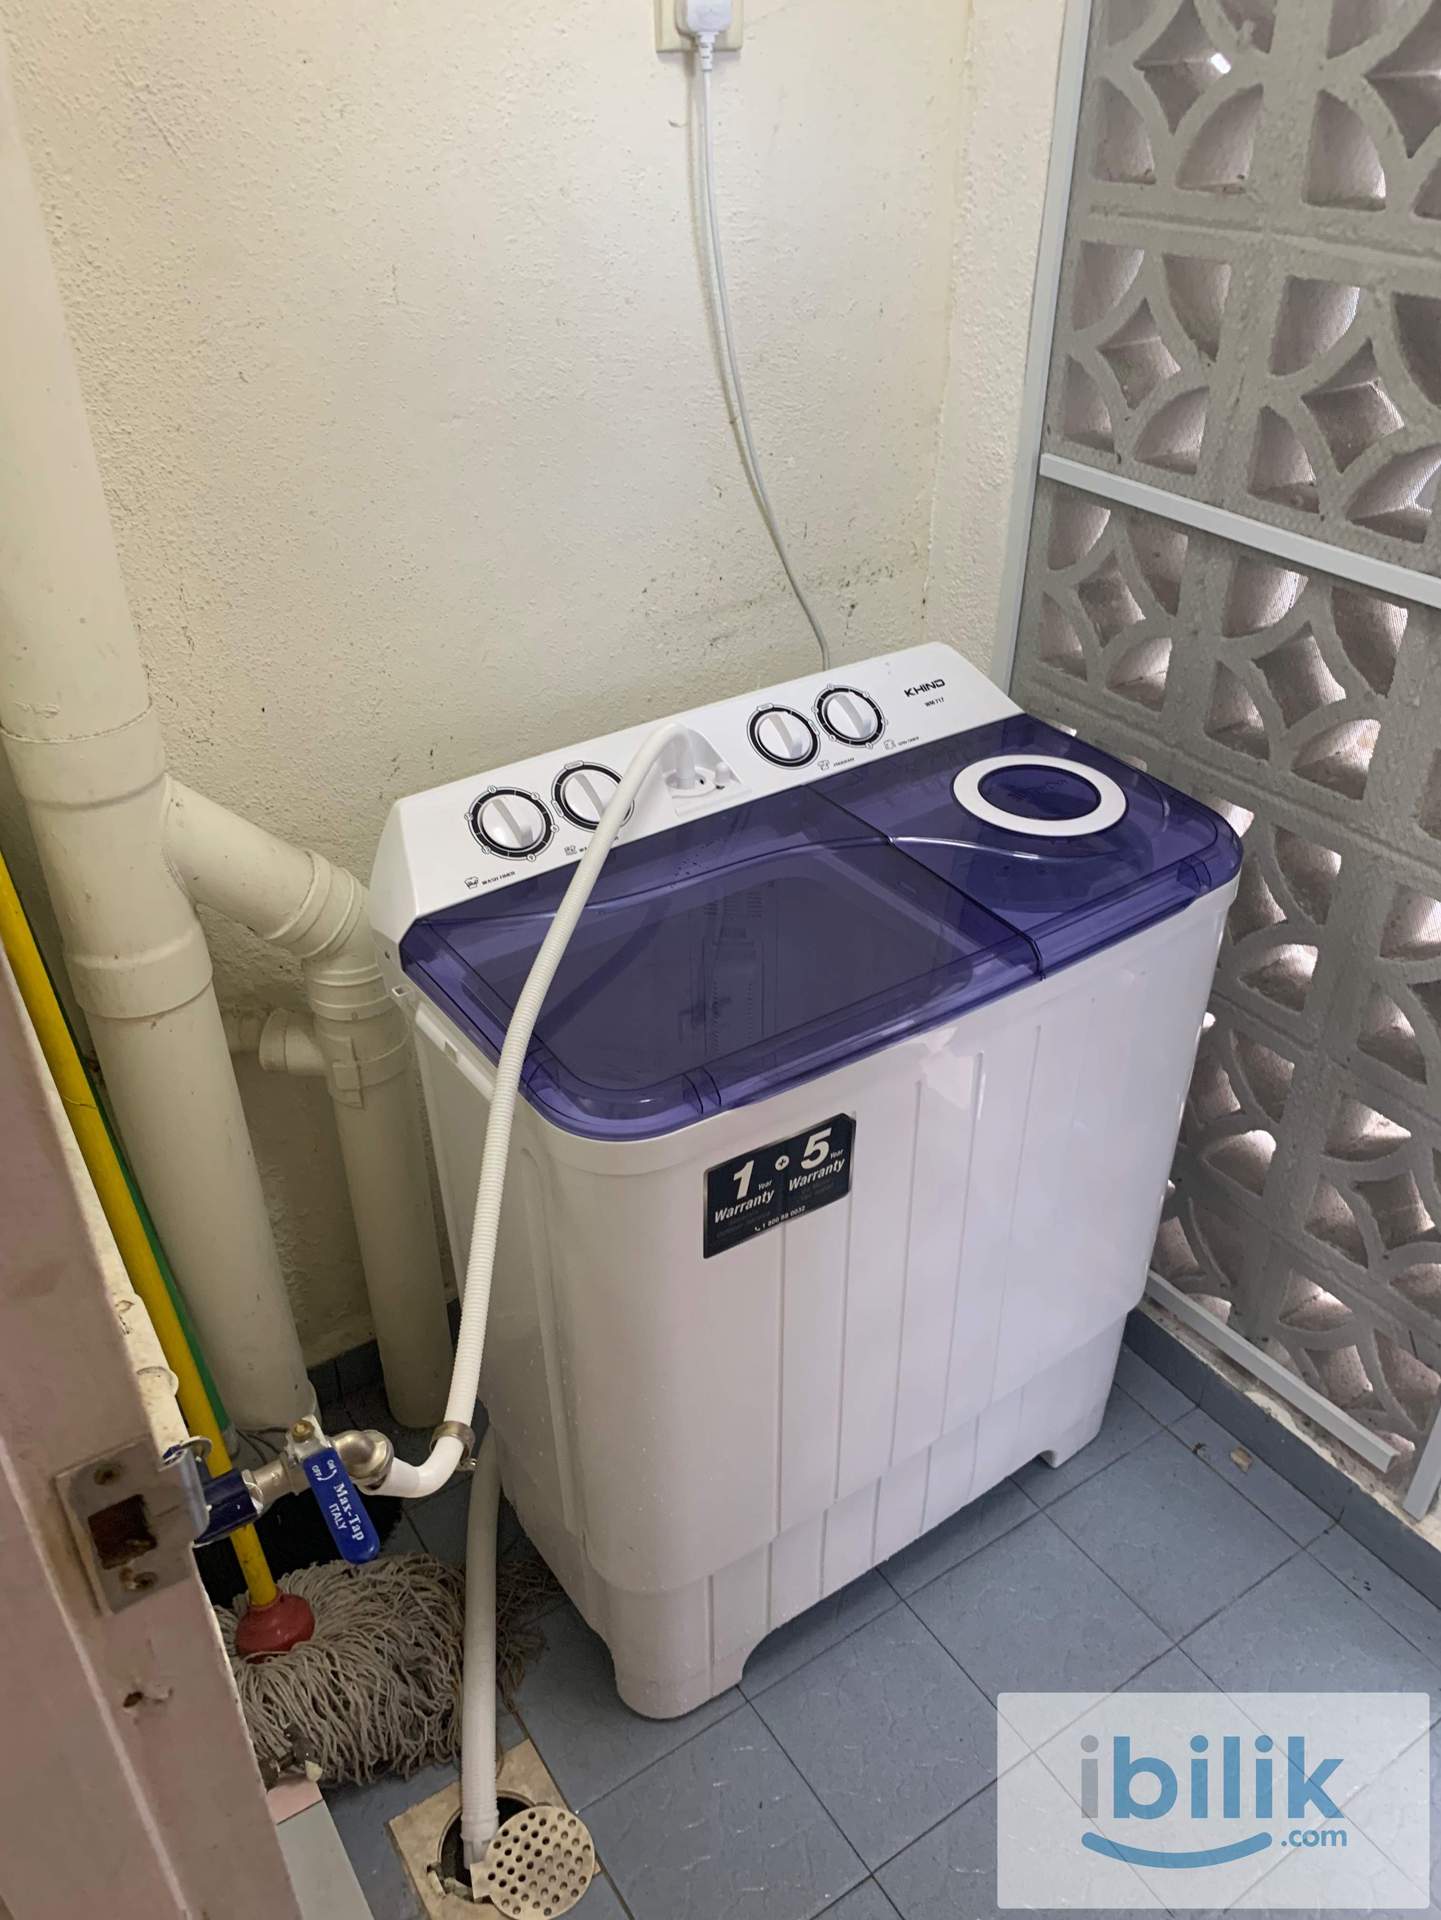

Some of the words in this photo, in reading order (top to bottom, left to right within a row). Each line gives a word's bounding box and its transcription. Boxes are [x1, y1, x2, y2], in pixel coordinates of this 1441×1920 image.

[904, 679, 946, 697] KHIND
[800, 1127, 832, 1170] 5
[733, 1160, 755, 1200] 1
[788, 1158, 846, 1192] Warranty
[714, 1189, 775, 1224] Warranty
[328, 1503, 348, 1530] ITALY
[333, 1482, 366, 1541] Max-Tap
